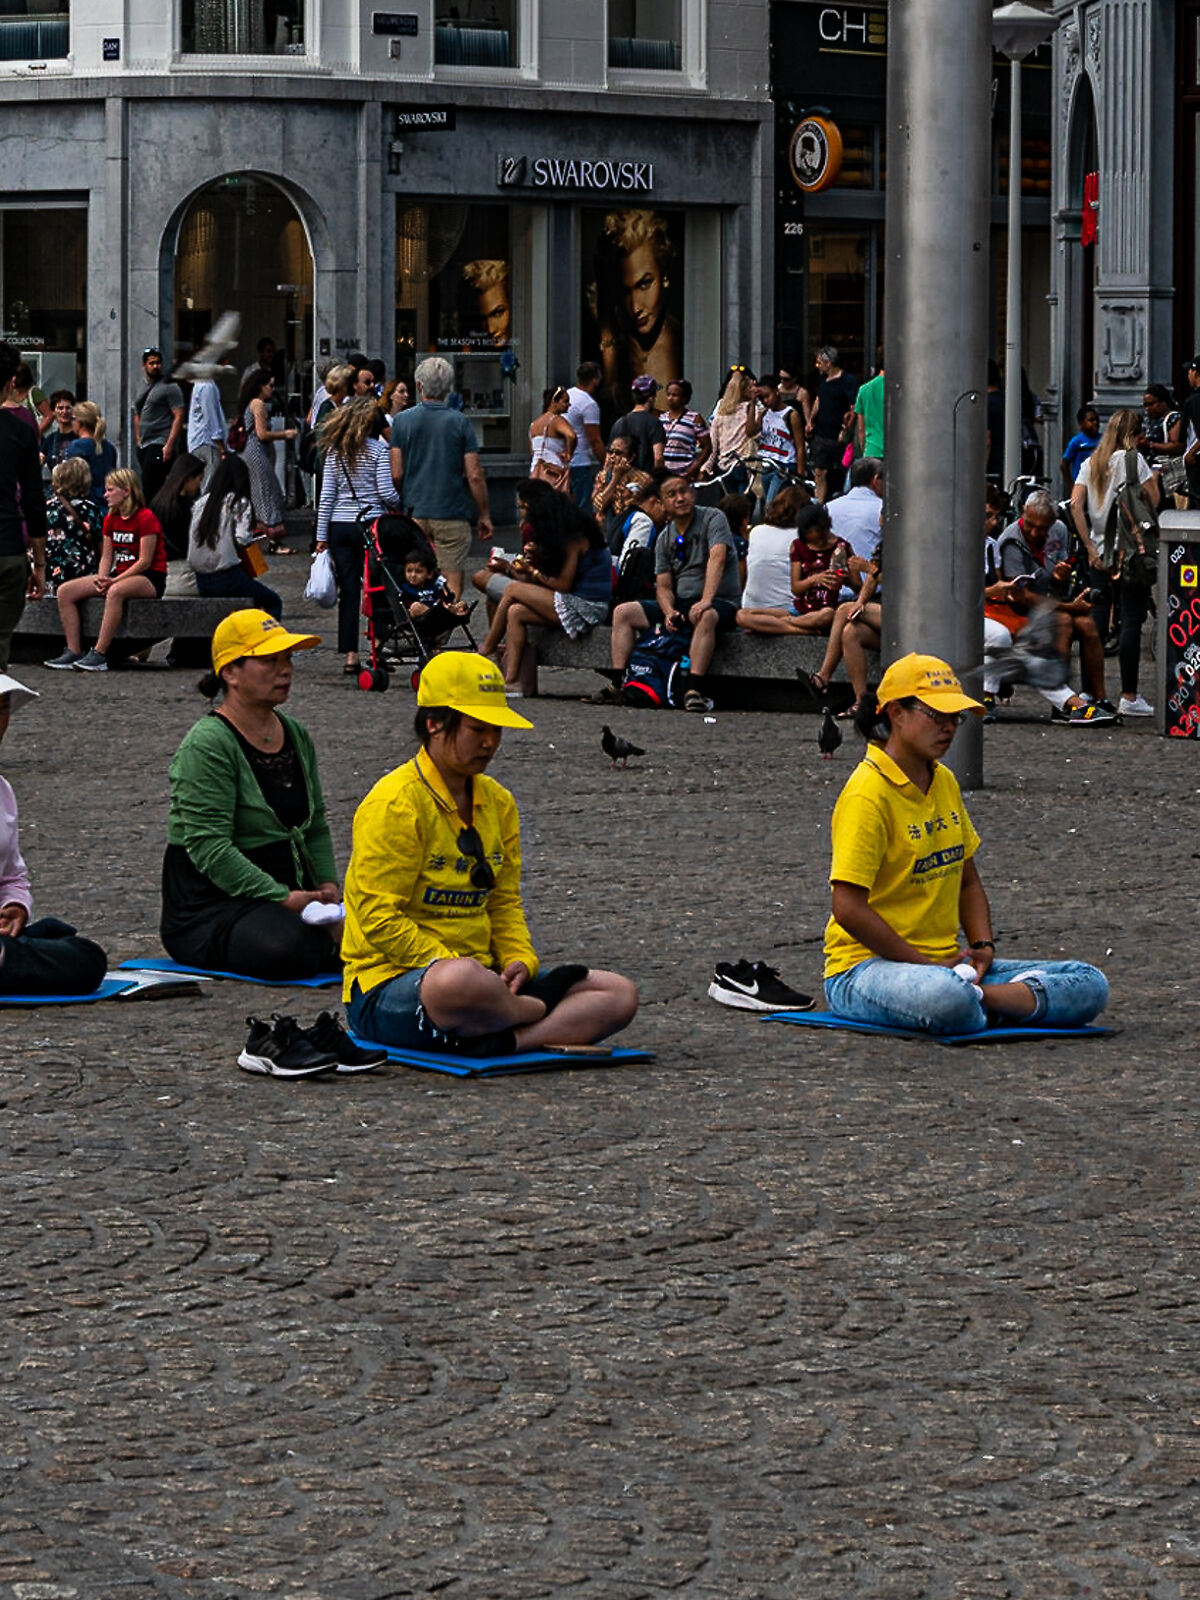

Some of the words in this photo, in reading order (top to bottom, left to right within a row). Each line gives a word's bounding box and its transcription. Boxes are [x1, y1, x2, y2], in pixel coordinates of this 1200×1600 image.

[398, 111, 447, 125] SWAROVSKI
[534, 158, 653, 190] SWAROVSKI
[784, 222, 804, 235] 226
[1170, 545, 1186, 564] 020
[1169, 598, 1200, 647] 020
